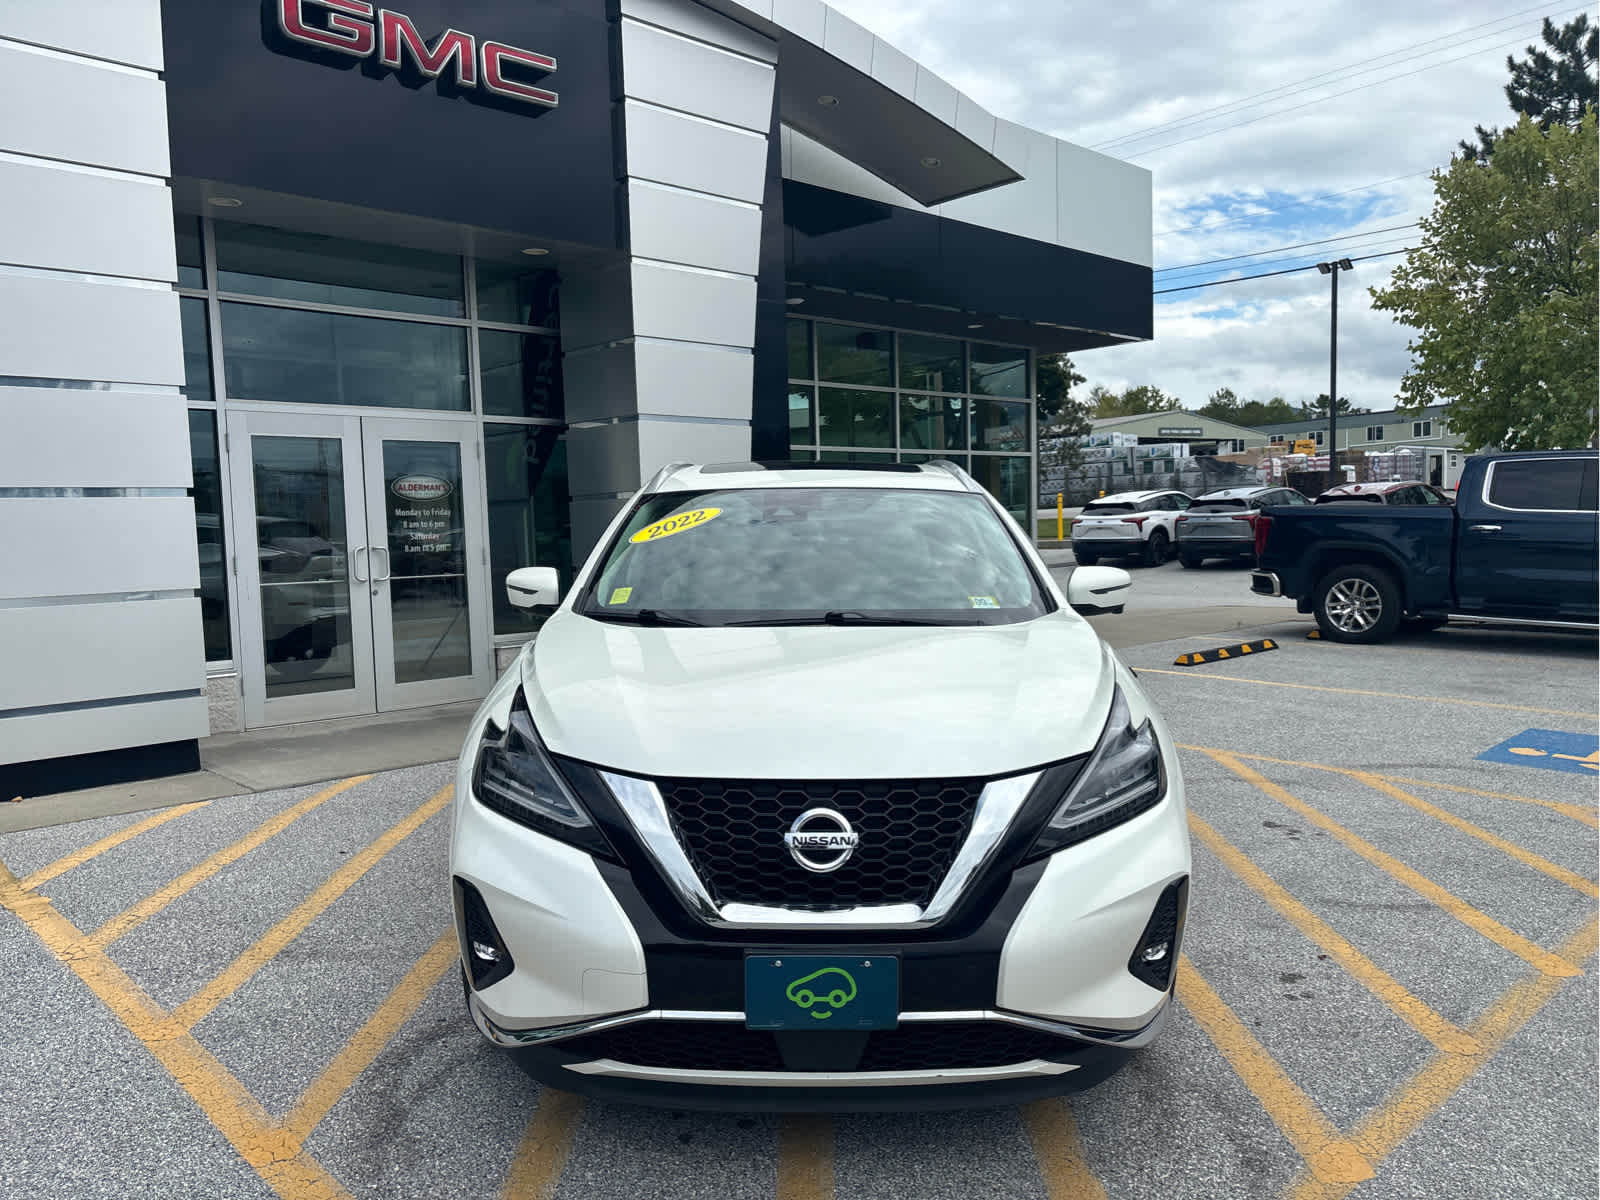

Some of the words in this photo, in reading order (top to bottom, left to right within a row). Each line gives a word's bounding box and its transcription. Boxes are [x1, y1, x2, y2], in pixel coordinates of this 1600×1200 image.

[278, 0, 559, 108] GMC
[397, 484, 447, 492] ALDERMAN'S
[395, 508, 421, 518] Monday
[423, 508, 431, 516] to
[432, 507, 451, 518] Friday
[648, 510, 707, 539] 2022
[410, 532, 440, 541] Saturday
[792, 836, 851, 846] NISSAN
